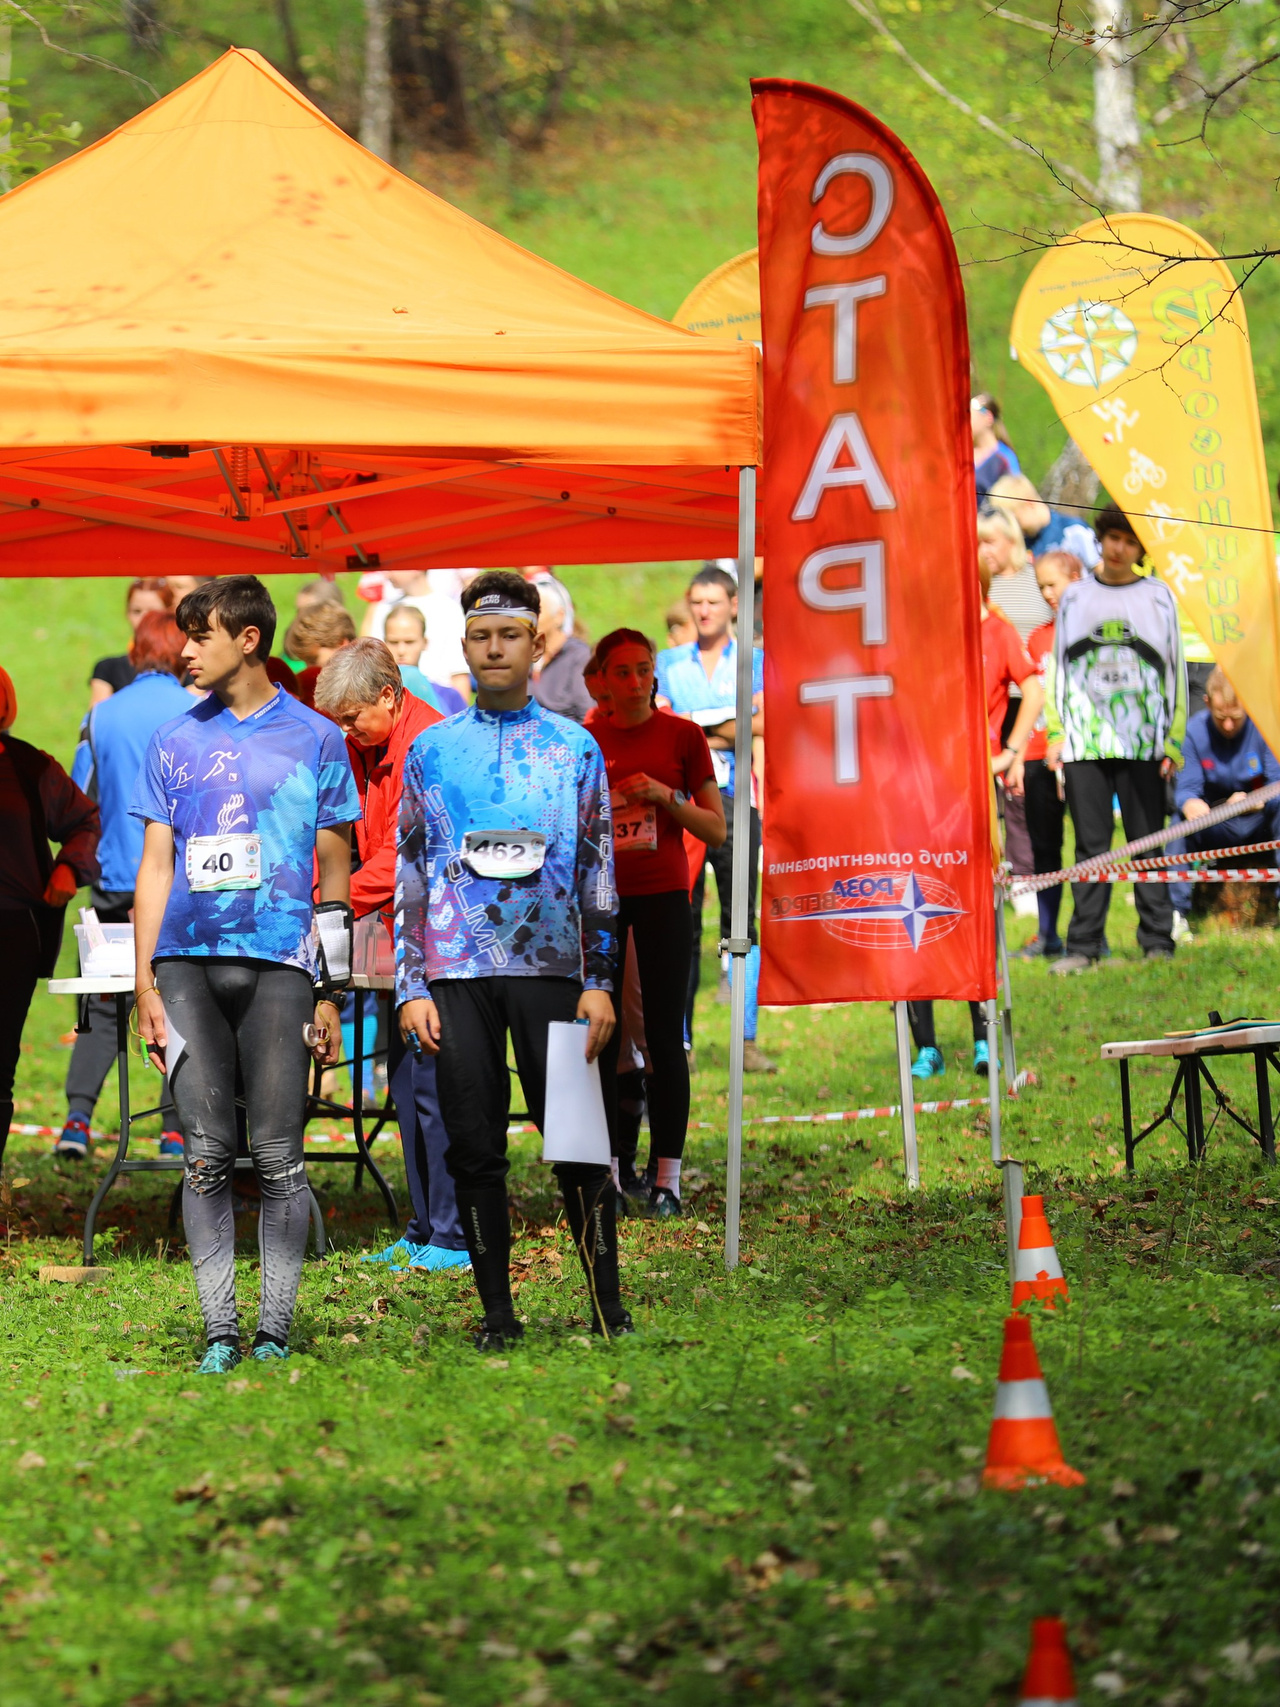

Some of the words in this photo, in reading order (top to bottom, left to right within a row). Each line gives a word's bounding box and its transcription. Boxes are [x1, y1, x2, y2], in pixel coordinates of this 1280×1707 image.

[612, 821, 642, 839] 37
[202, 852, 233, 873] 40
[473, 839, 526, 864] 462
[423, 784, 509, 968] SP-OLIMP
[470, 1206, 481, 1241] NORD
